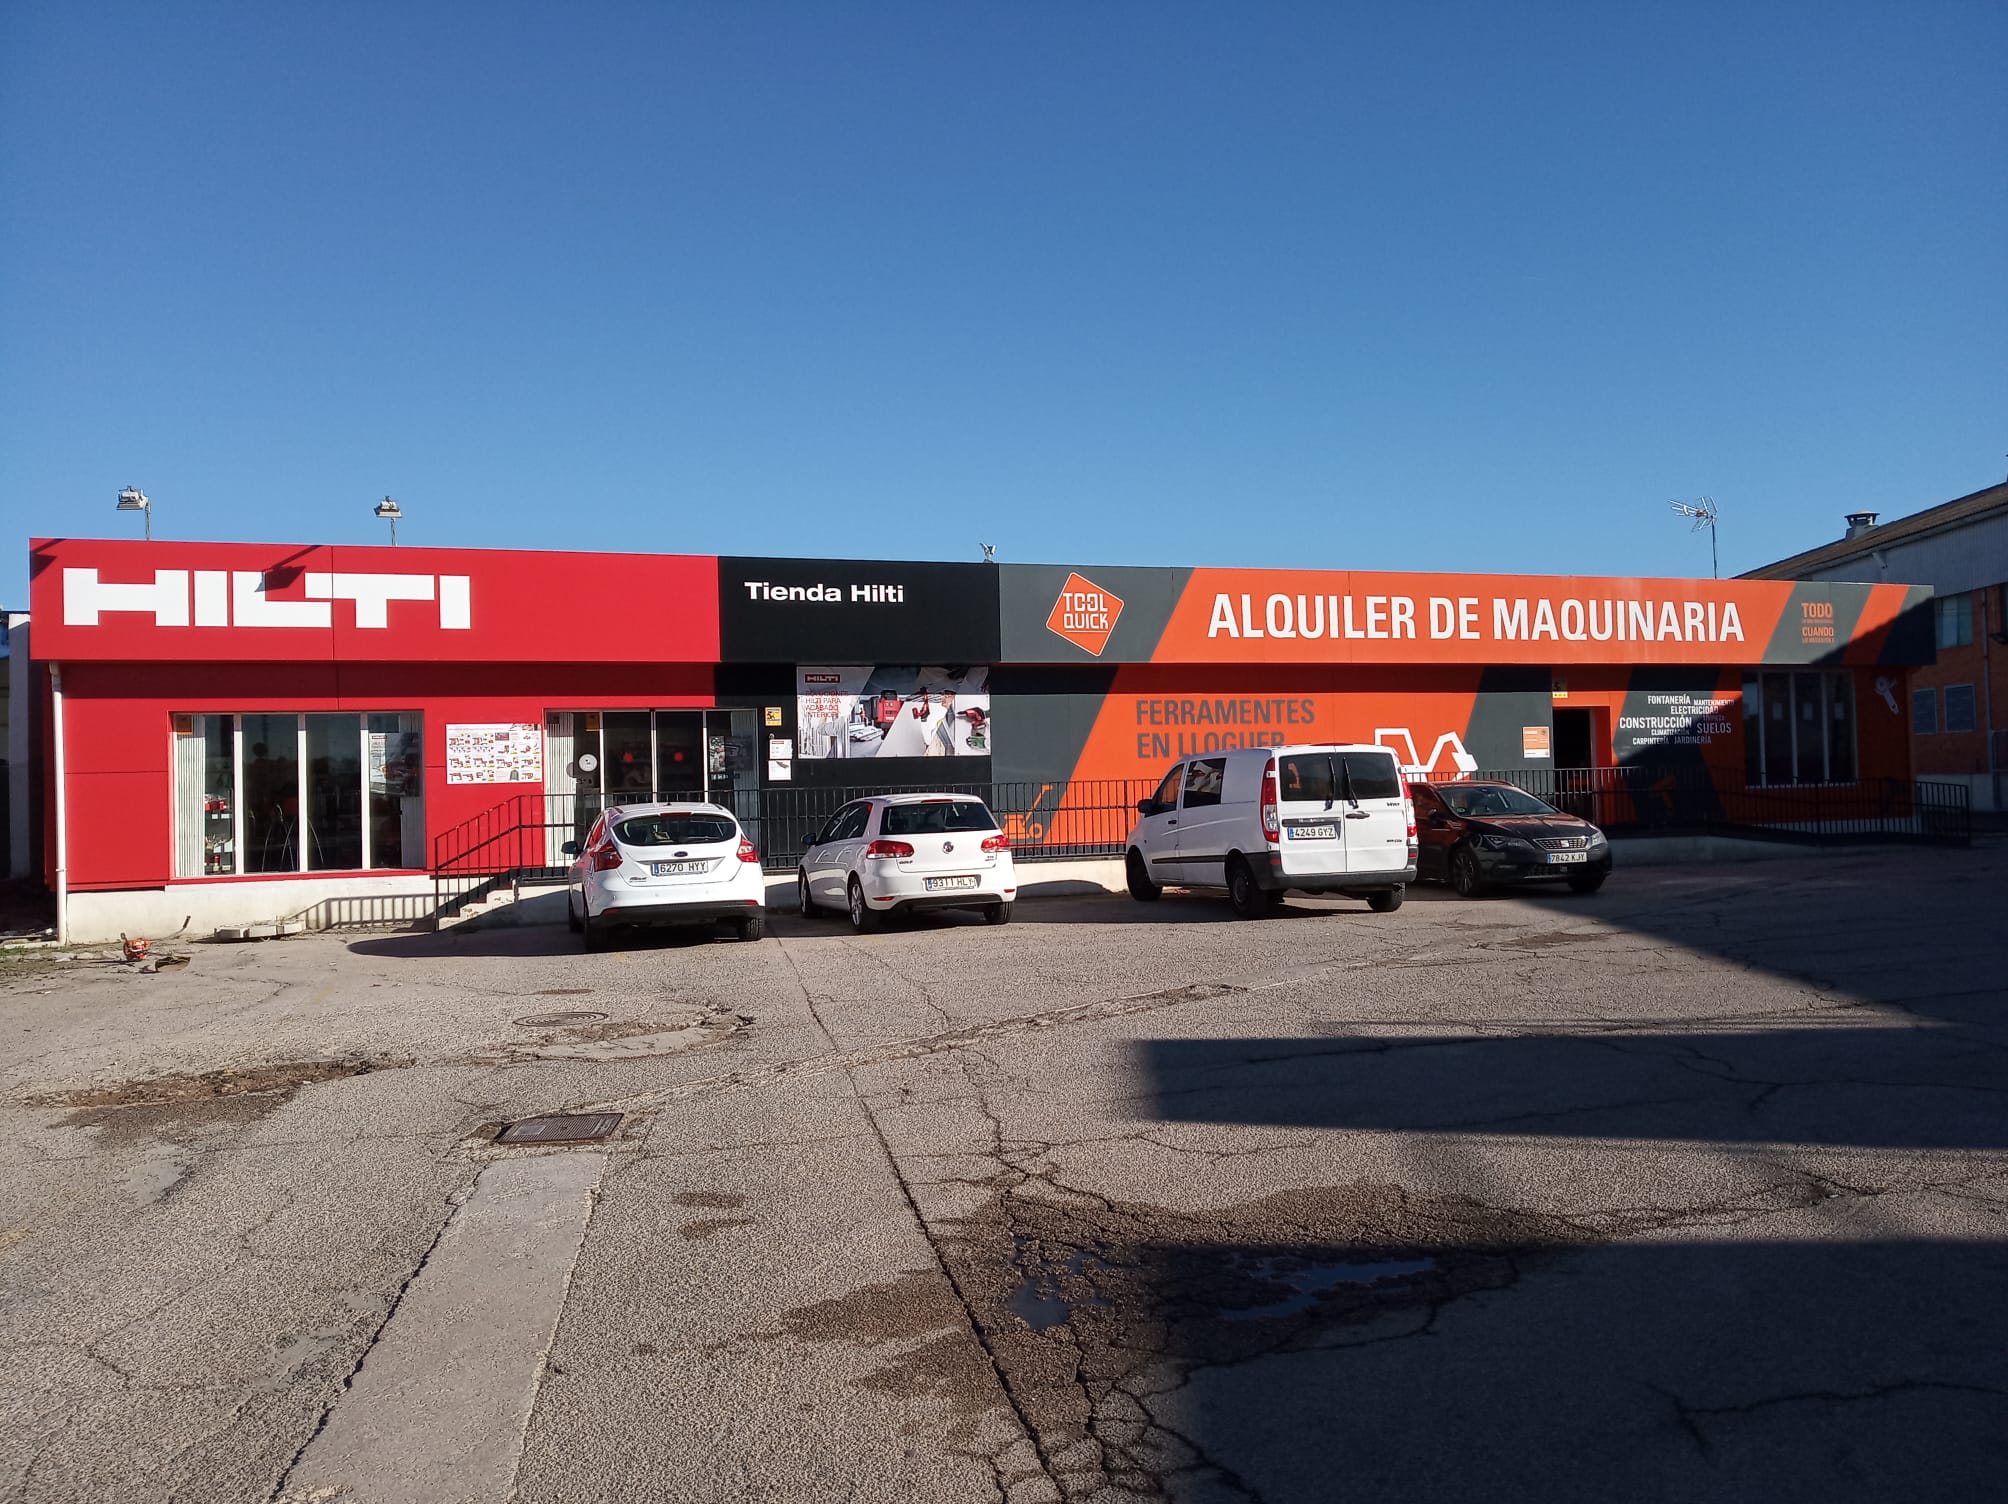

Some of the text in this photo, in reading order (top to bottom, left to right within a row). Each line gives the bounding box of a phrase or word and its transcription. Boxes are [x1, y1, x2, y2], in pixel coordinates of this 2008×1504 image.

[744, 581, 905, 603] Tienda Hilti
[62, 567, 471, 630] HILTI
[1063, 592, 1108, 612] TOOL
[1801, 602, 1834, 618] TODO
[1063, 613, 1109, 629] QUICK
[1207, 593, 1745, 642] ALQUILER DE MAQUINARIA
[1802, 627, 1834, 637] CUANDO
[1647, 693, 1691, 705] FONTANERÍA
[1135, 698, 1316, 726] FERRAMENTES
[1670, 705, 1719, 715] ELECTRICIDAD
[1619, 714, 1692, 729] CONSTRUCCIÓN
[1696, 722, 1732, 734] SUELOS
[1137, 732, 1171, 759] EN
[1632, 735, 1670, 745] CARPINTERÍA
[1674, 735, 1712, 745] JARDINERÍA
[1295, 827, 1334, 837] 4249 GYZ
[1551, 854, 1570, 862] 7842
[660, 862, 706, 873] 6270 HYY
[933, 878, 955, 888] 9311
